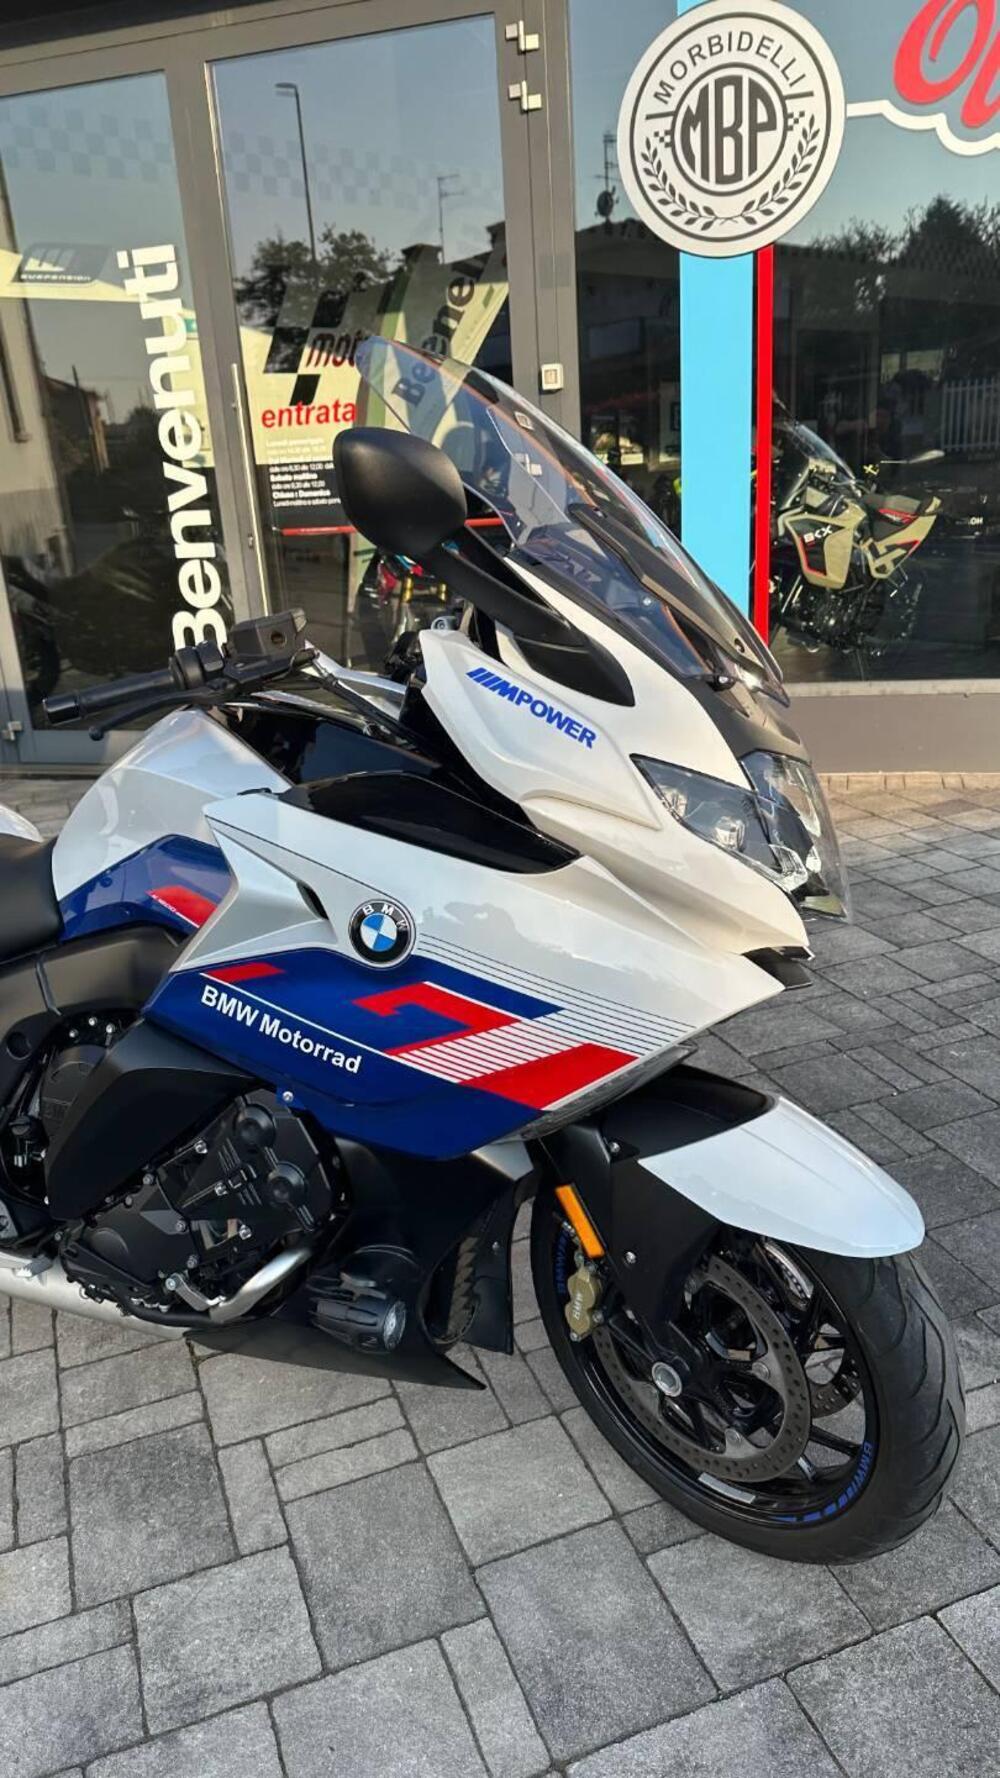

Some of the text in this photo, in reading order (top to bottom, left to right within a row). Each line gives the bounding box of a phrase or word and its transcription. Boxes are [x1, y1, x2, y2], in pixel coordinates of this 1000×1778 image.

[653, 31, 807, 105] MORBIDELLI
[680, 74, 778, 186] MBP
[117, 244, 228, 658] Benvenuti
[261, 399, 357, 428] entrata
[362, 903, 409, 931] BMW
[200, 984, 362, 1075] BMW Motorrad
